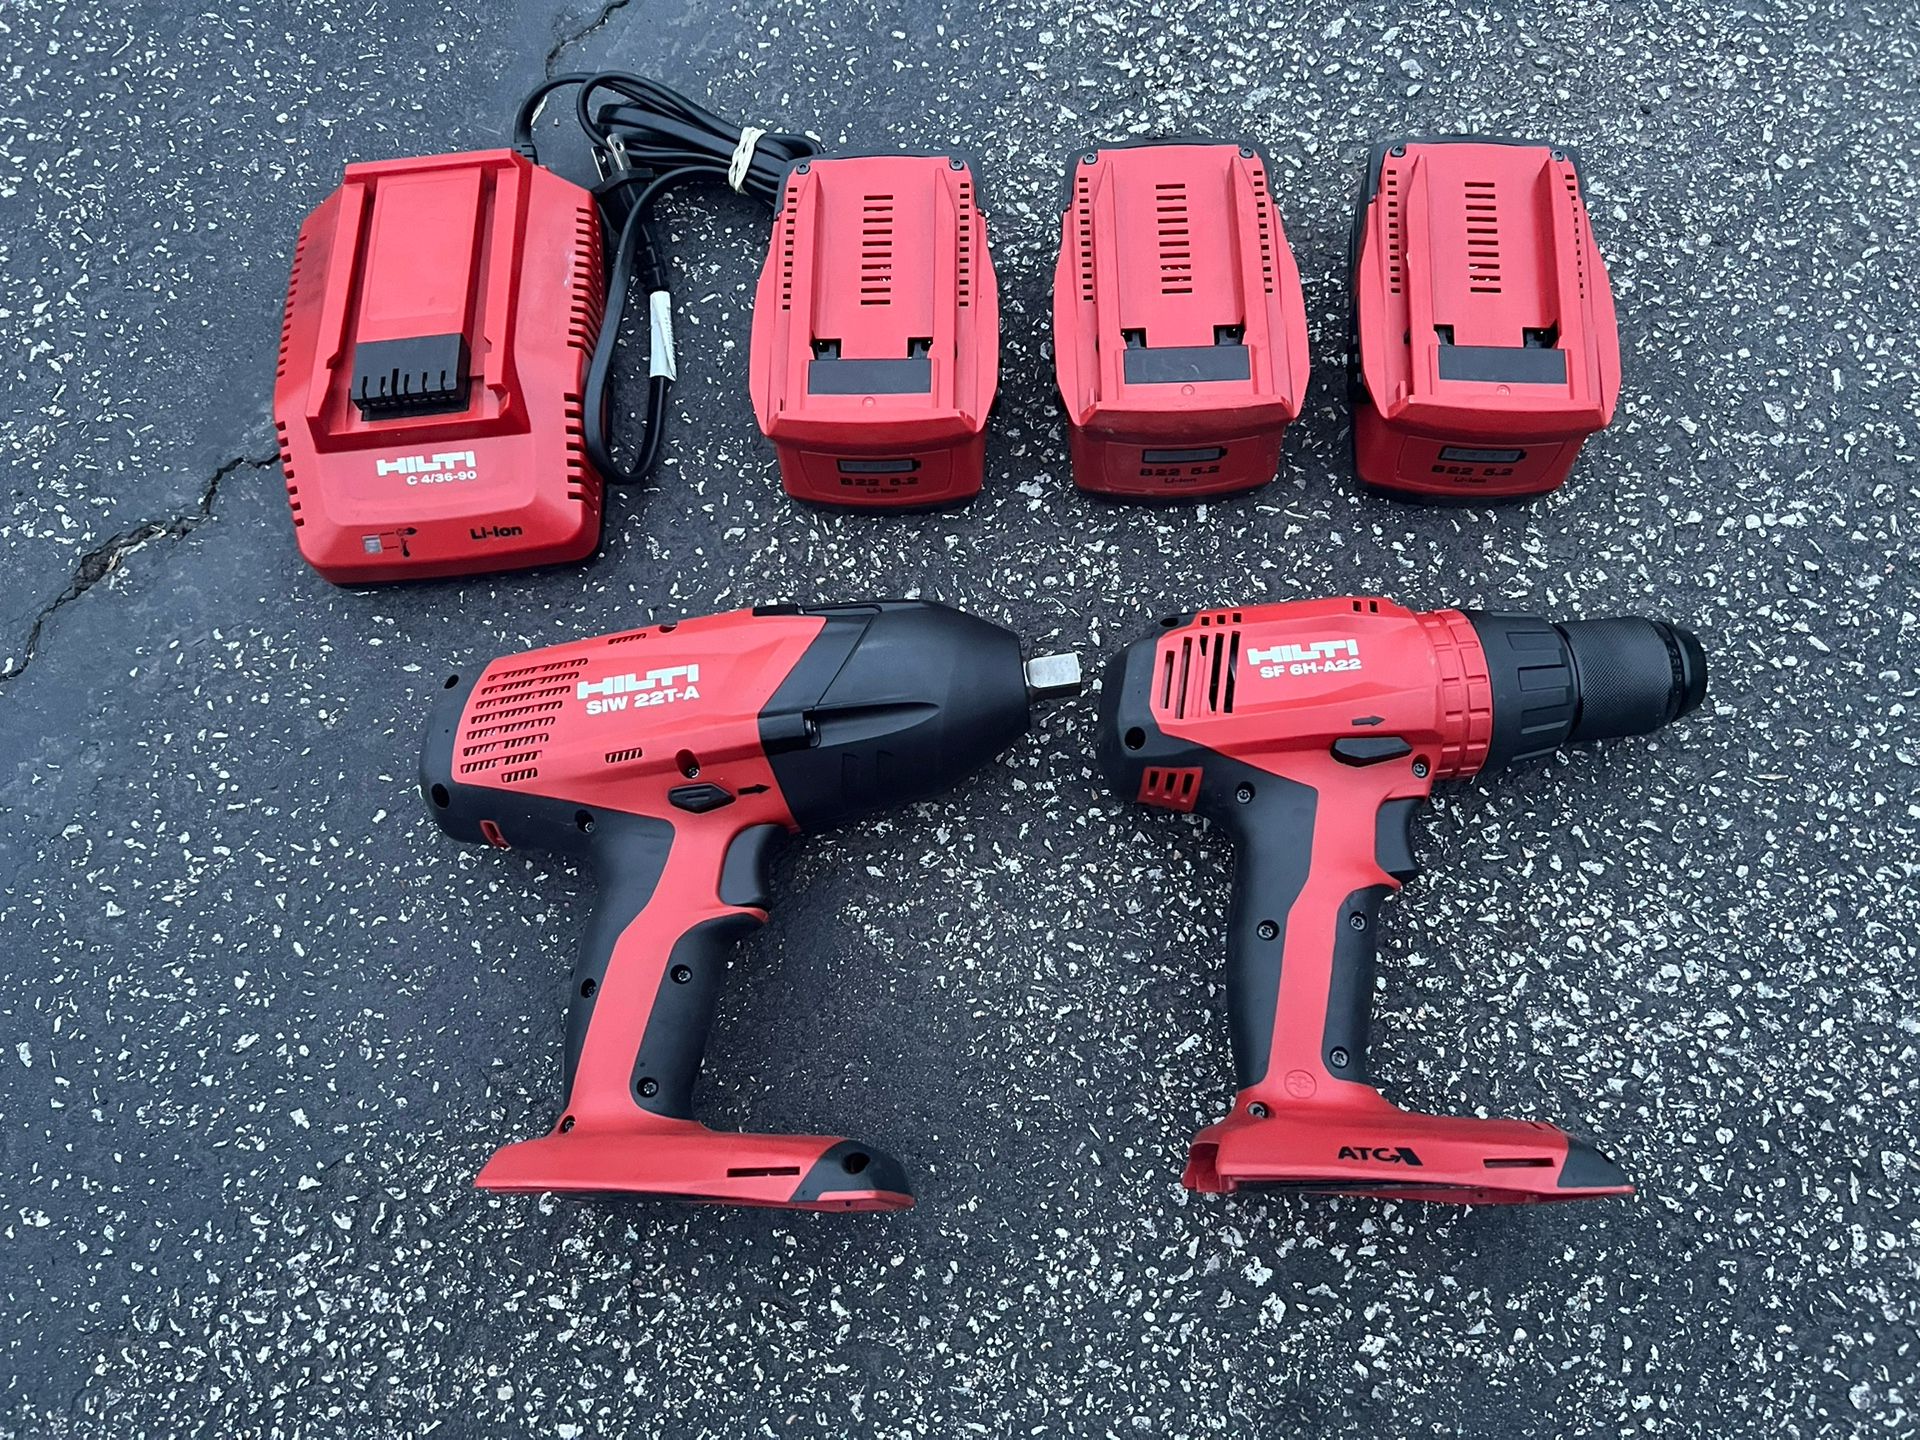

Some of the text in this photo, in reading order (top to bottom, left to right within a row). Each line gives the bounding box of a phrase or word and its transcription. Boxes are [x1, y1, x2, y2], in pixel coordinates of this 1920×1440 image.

[376, 451, 477, 476] HILTI
[1139, 465, 1220, 477] B22 5.2
[1431, 464, 1514, 476] B22 5.2
[406, 470, 477, 485] C 4/36-90
[469, 526, 523, 540] Li-Ion
[1246, 639, 1359, 665] HILTI
[1260, 658, 1362, 679] SF 6H-A22
[577, 664, 699, 699] HILTI
[586, 685, 700, 715] SIW 22T-A
